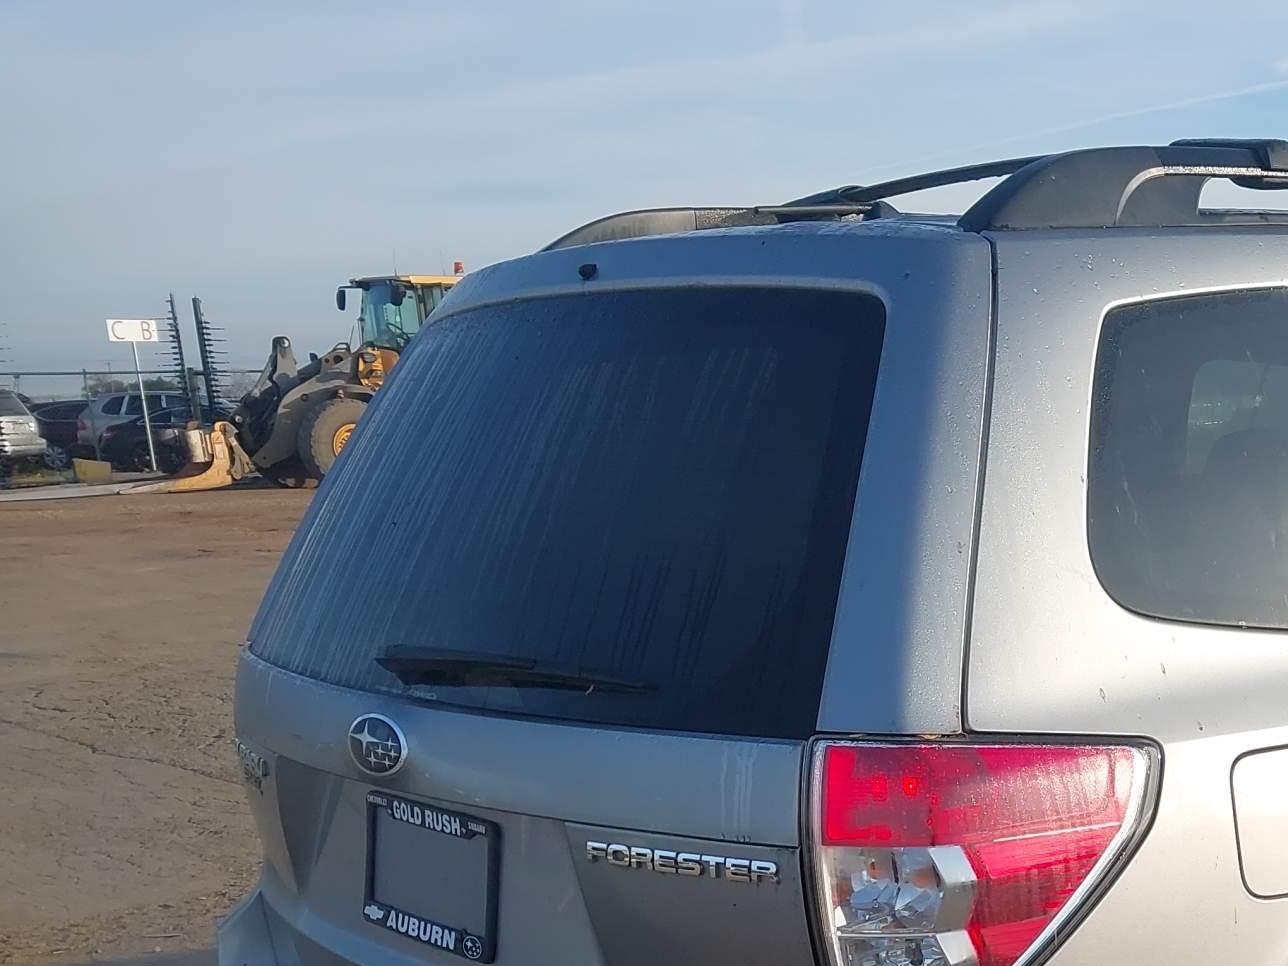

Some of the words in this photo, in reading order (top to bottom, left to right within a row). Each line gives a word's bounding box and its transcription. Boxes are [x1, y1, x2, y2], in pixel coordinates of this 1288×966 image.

[111, 320, 126, 340] C
[140, 320, 153, 340] B
[392, 800, 422, 826] GOLD
[425, 809, 461, 836] RUSH
[586, 840, 781, 885] FORESTER
[386, 909, 456, 950] AUBURN
